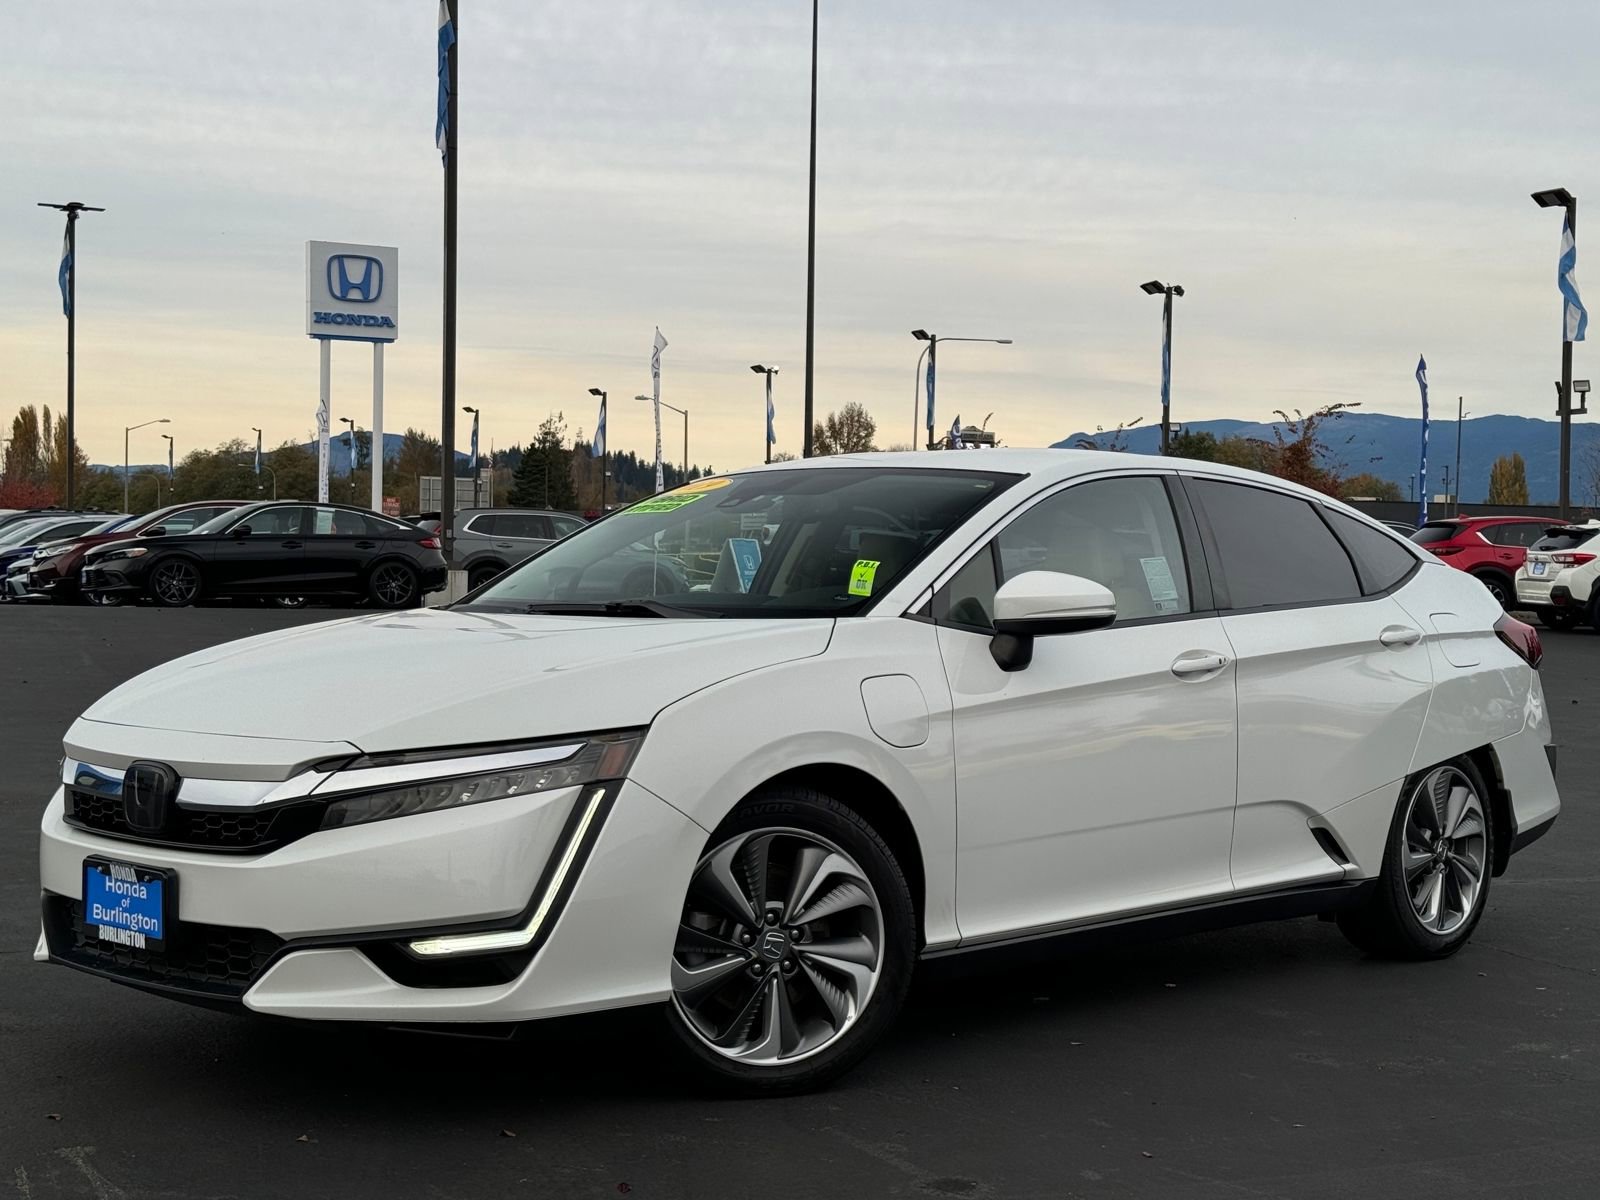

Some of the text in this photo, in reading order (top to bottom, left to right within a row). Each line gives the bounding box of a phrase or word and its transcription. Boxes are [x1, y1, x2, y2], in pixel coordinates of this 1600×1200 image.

[313, 311, 396, 328] HONDA
[110, 864, 137, 882] HONDA
[105, 876, 147, 899] Honda
[121, 897, 130, 908] of
[93, 903, 158, 931] Burlington
[99, 924, 146, 949] BURLINGTON
